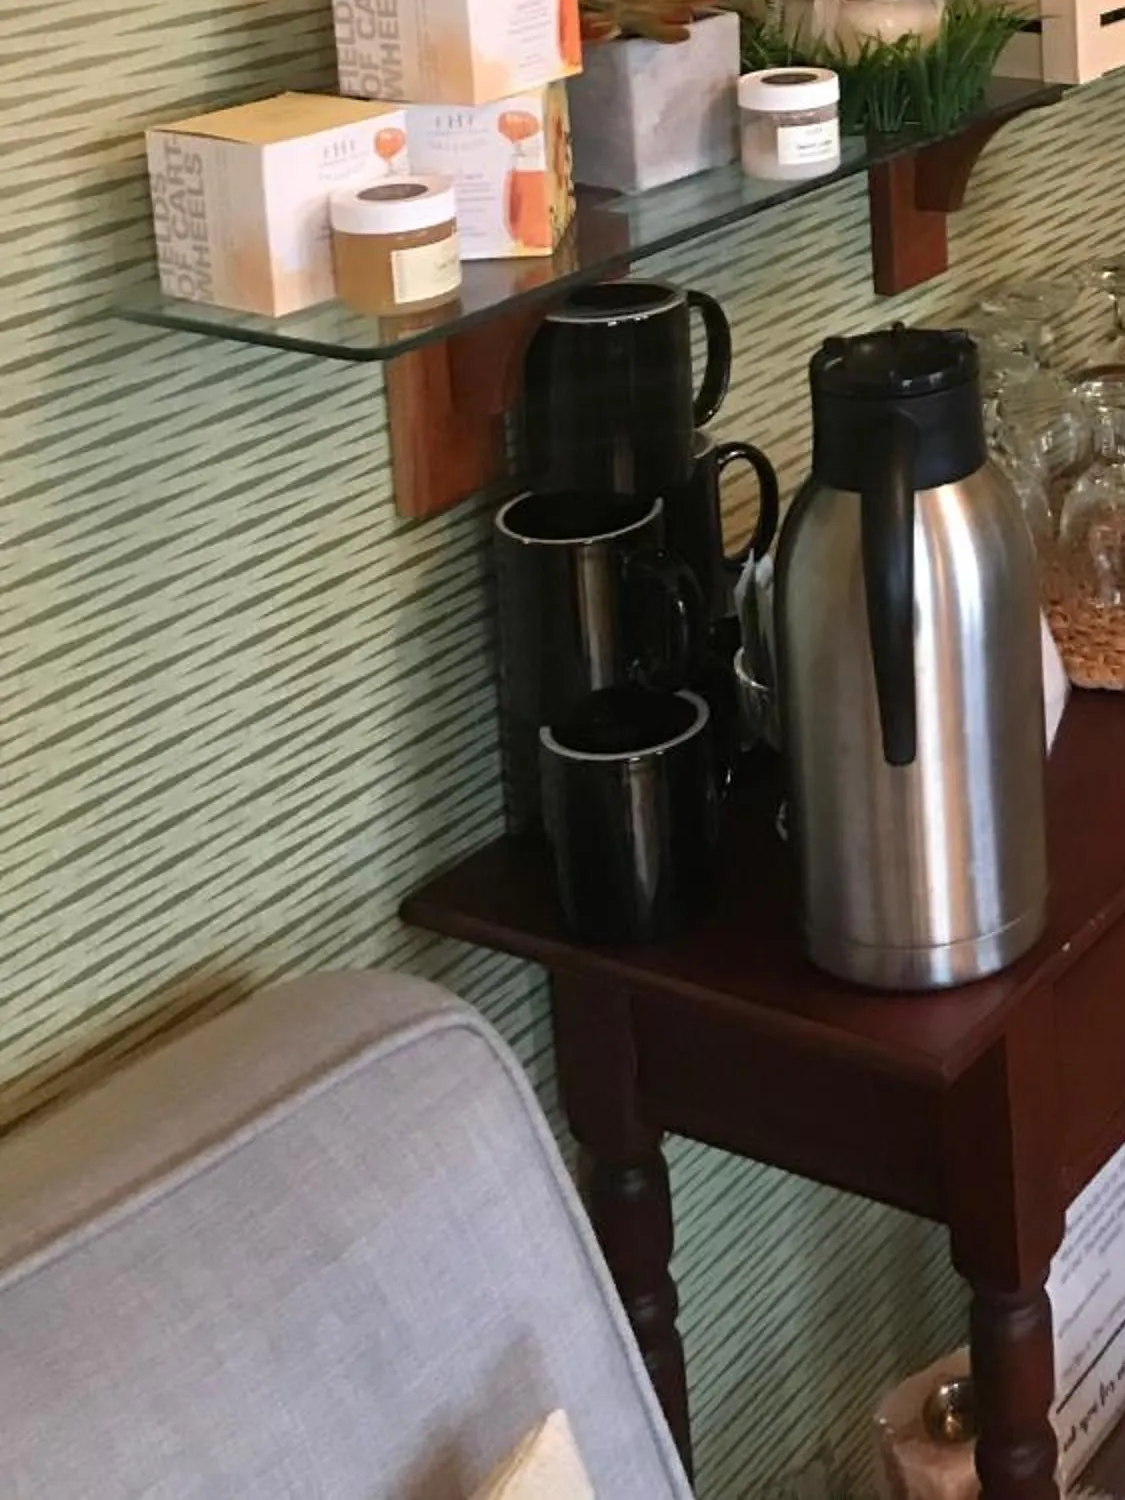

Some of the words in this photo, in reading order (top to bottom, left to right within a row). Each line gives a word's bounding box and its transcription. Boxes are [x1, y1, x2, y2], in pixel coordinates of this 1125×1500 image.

[359, 52, 383, 97] OF
[184, 152, 215, 301] WHEELS
[175, 252, 197, 297] OF
